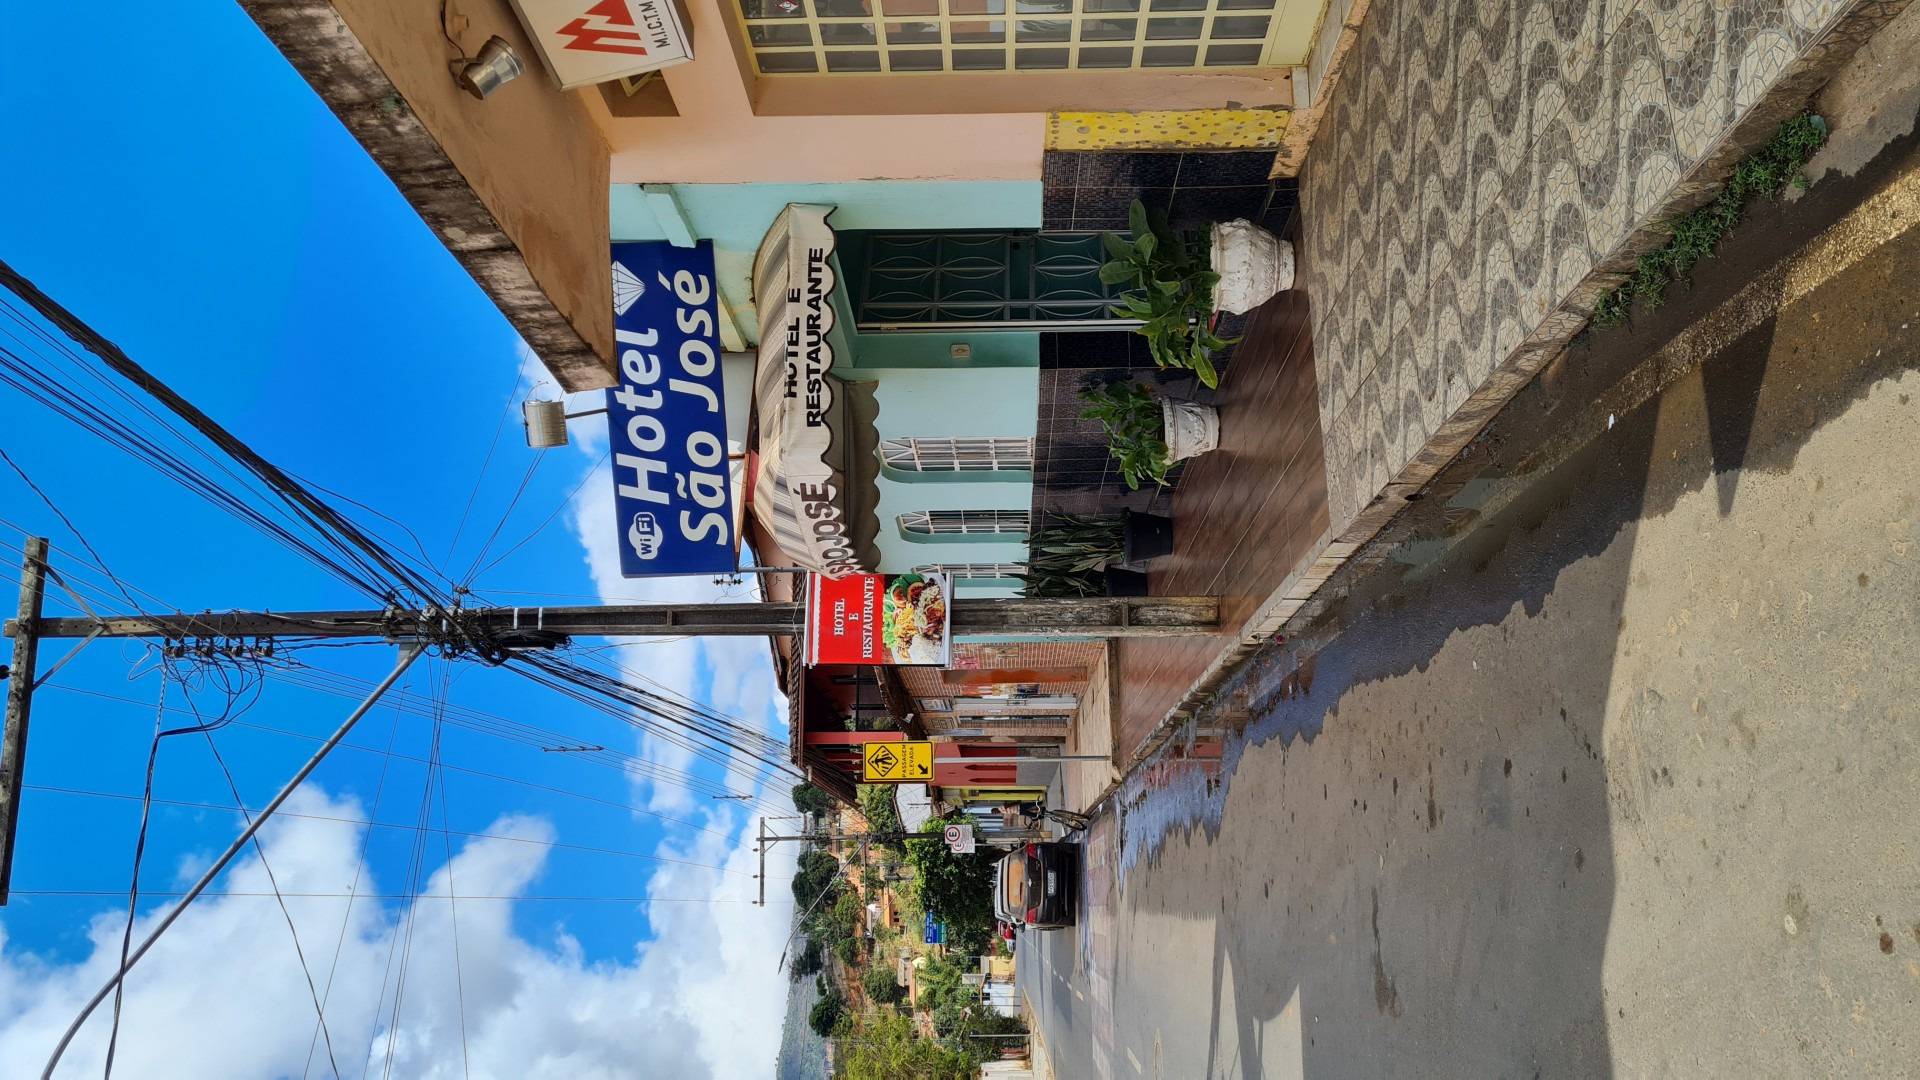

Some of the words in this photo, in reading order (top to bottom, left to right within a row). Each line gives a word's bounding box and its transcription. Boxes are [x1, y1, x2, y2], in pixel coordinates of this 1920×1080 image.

[787, 288, 801, 303] E
[658, 269, 719, 412] José
[784, 317, 800, 398] HOTEL
[806, 248, 823, 427] RESTAURANTE
[615, 328, 669, 505] Hotel
[674, 431, 728, 546] São
[793, 483, 843, 546] JOSÉ
[834, 598, 844, 635] HOTEL
[863, 577, 874, 658] RESTAURANTE
